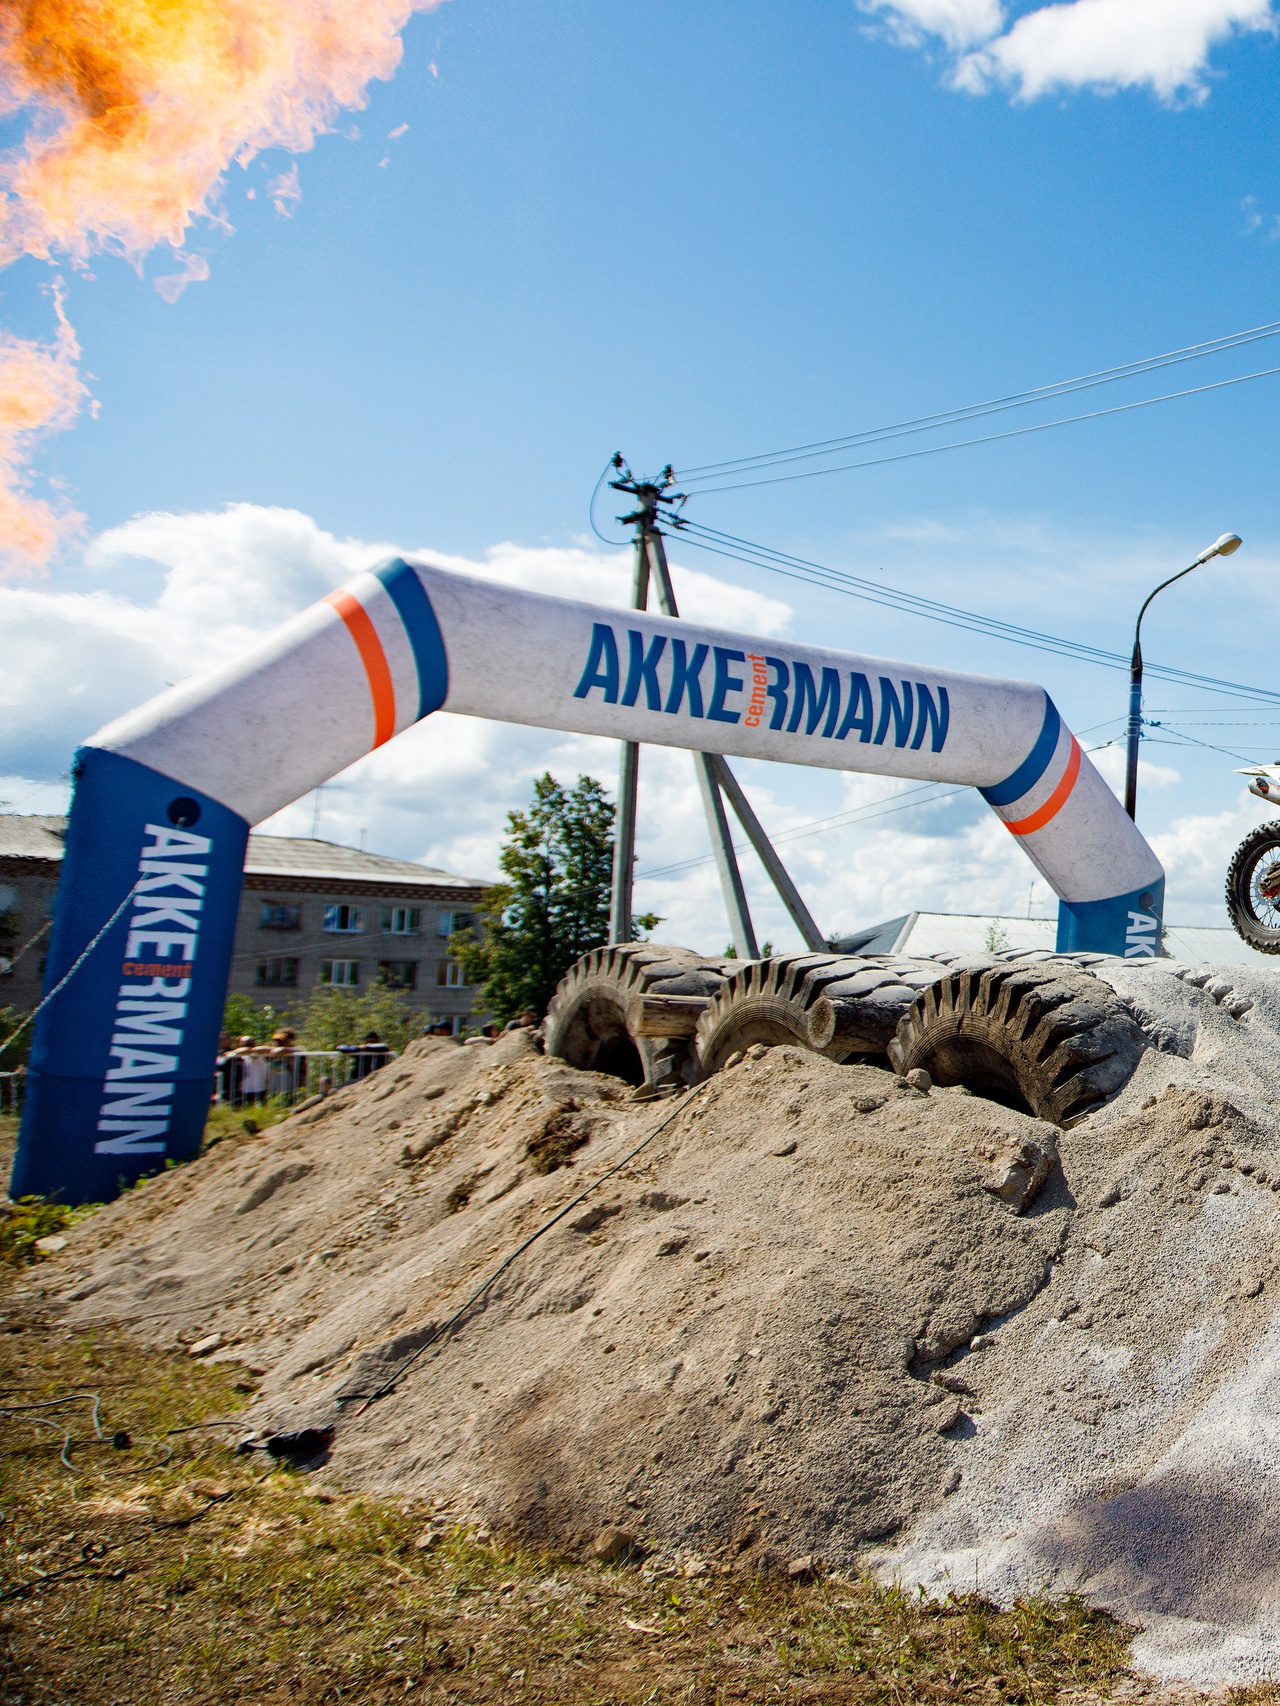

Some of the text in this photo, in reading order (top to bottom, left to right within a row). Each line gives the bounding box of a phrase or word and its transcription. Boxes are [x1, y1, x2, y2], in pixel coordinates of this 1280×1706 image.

[572, 622, 950, 753] AKKERMANN
[745, 654, 765, 727] cement
[94, 824, 213, 1154] AKKERMANN
[122, 962, 193, 978] cement
